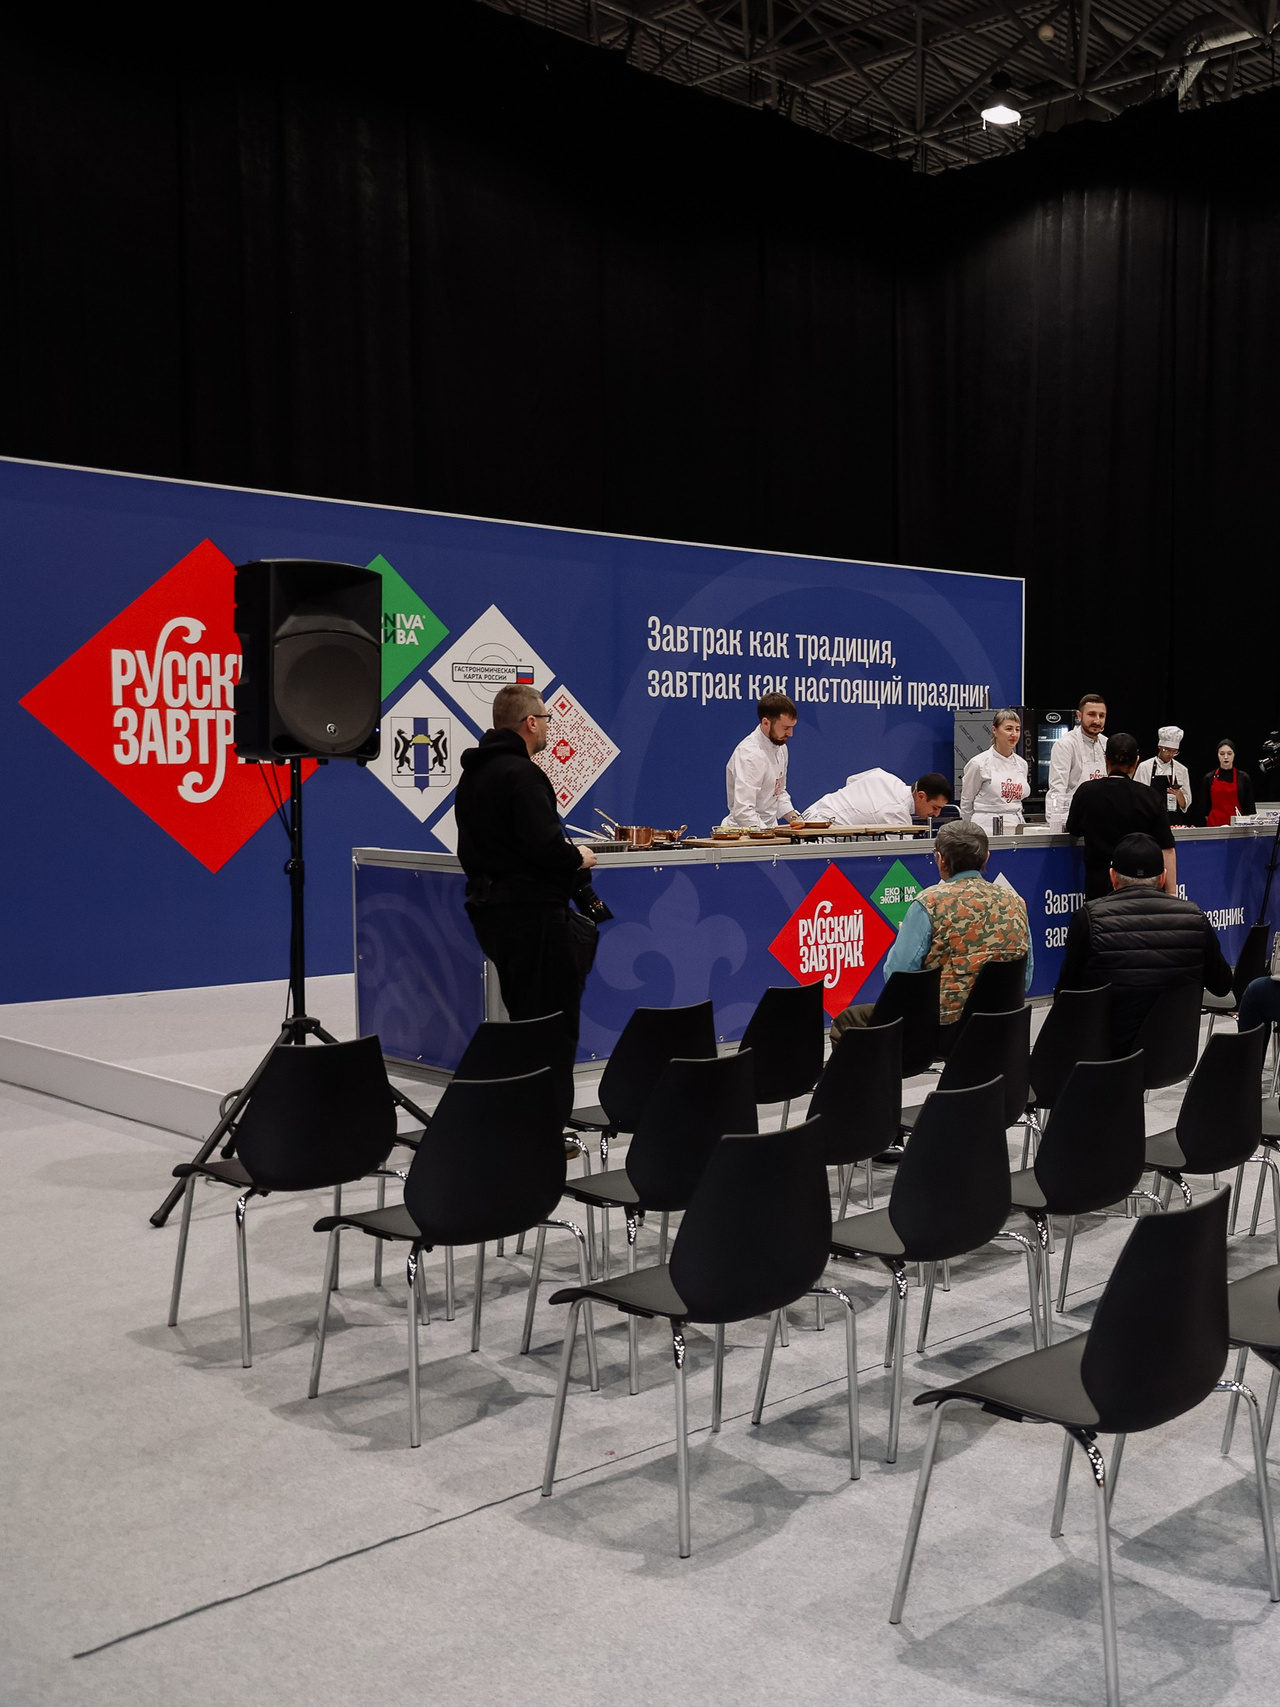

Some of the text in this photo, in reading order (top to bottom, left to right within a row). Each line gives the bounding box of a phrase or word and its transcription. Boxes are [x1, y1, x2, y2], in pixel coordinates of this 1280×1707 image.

[381, 612, 425, 630] NIVA
[647, 615, 897, 669] Завтрак как традиция,
[111, 616, 243, 709] РУССК
[454, 665, 516, 674] ГАСТРОНОМИЧЕСКАЯ
[647, 669, 990, 712] завтрак как настоящий праздник
[798, 900, 864, 946] РУССКИЙ
[1045, 889, 1085, 915] Завтр
[1204, 907, 1245, 931] аздник
[799, 941, 865, 989] ЗАВТРАК
